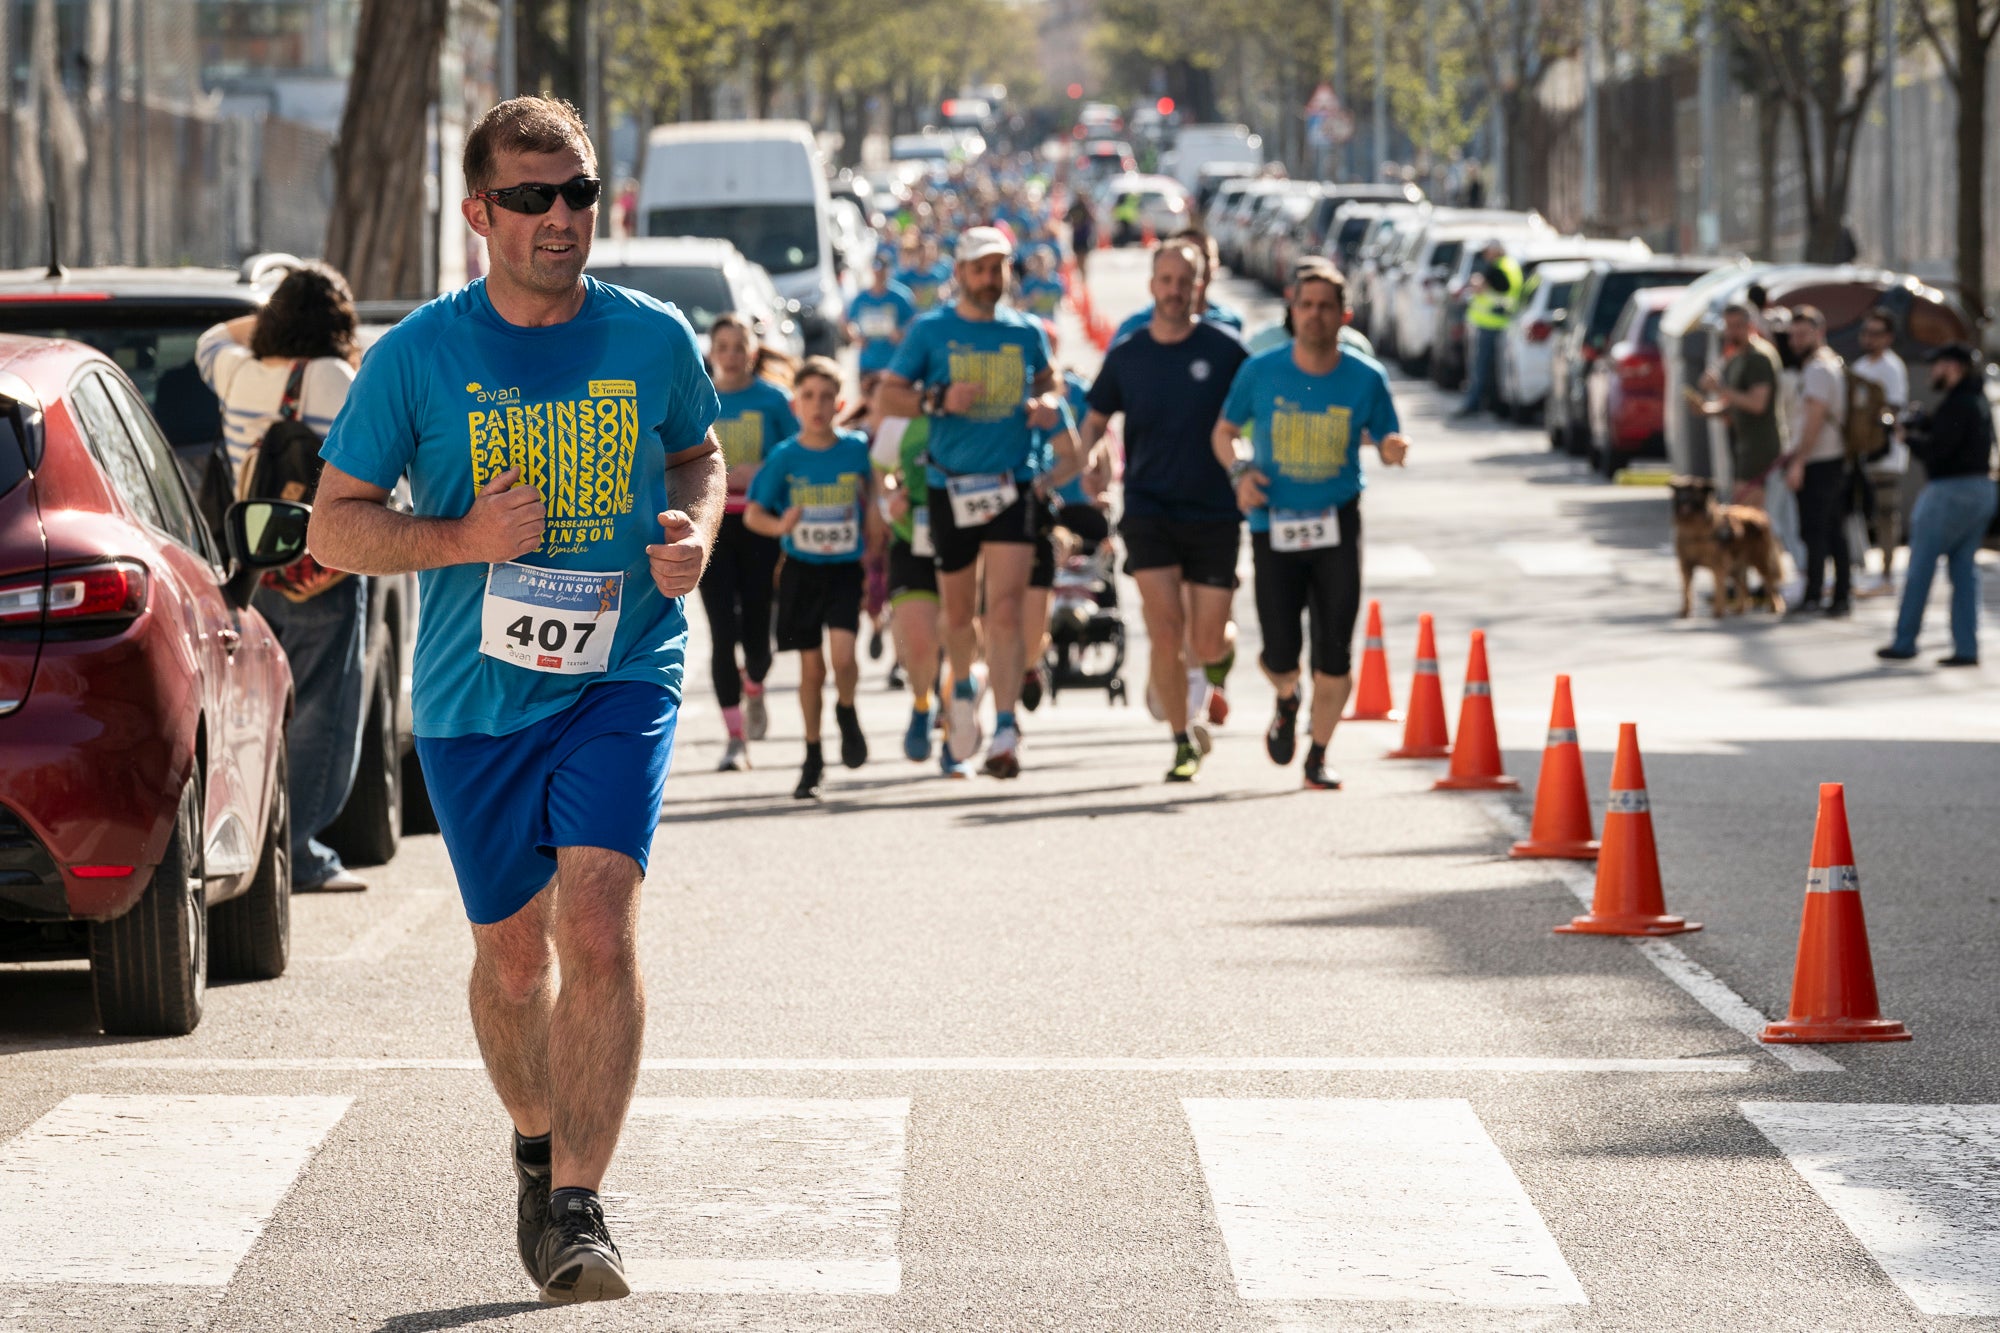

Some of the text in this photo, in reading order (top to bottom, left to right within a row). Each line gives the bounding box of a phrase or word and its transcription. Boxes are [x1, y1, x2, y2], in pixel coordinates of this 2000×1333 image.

[477, 386, 520, 403] avan
[468, 398, 637, 432] PARKINSON
[547, 518, 614, 528] PASSEJADA PEL
[518, 574, 602, 594] PARKINSON
[557, 575, 592, 583] PASSEJADA
[506, 615, 597, 654] 407
[509, 650, 531, 661] avan
